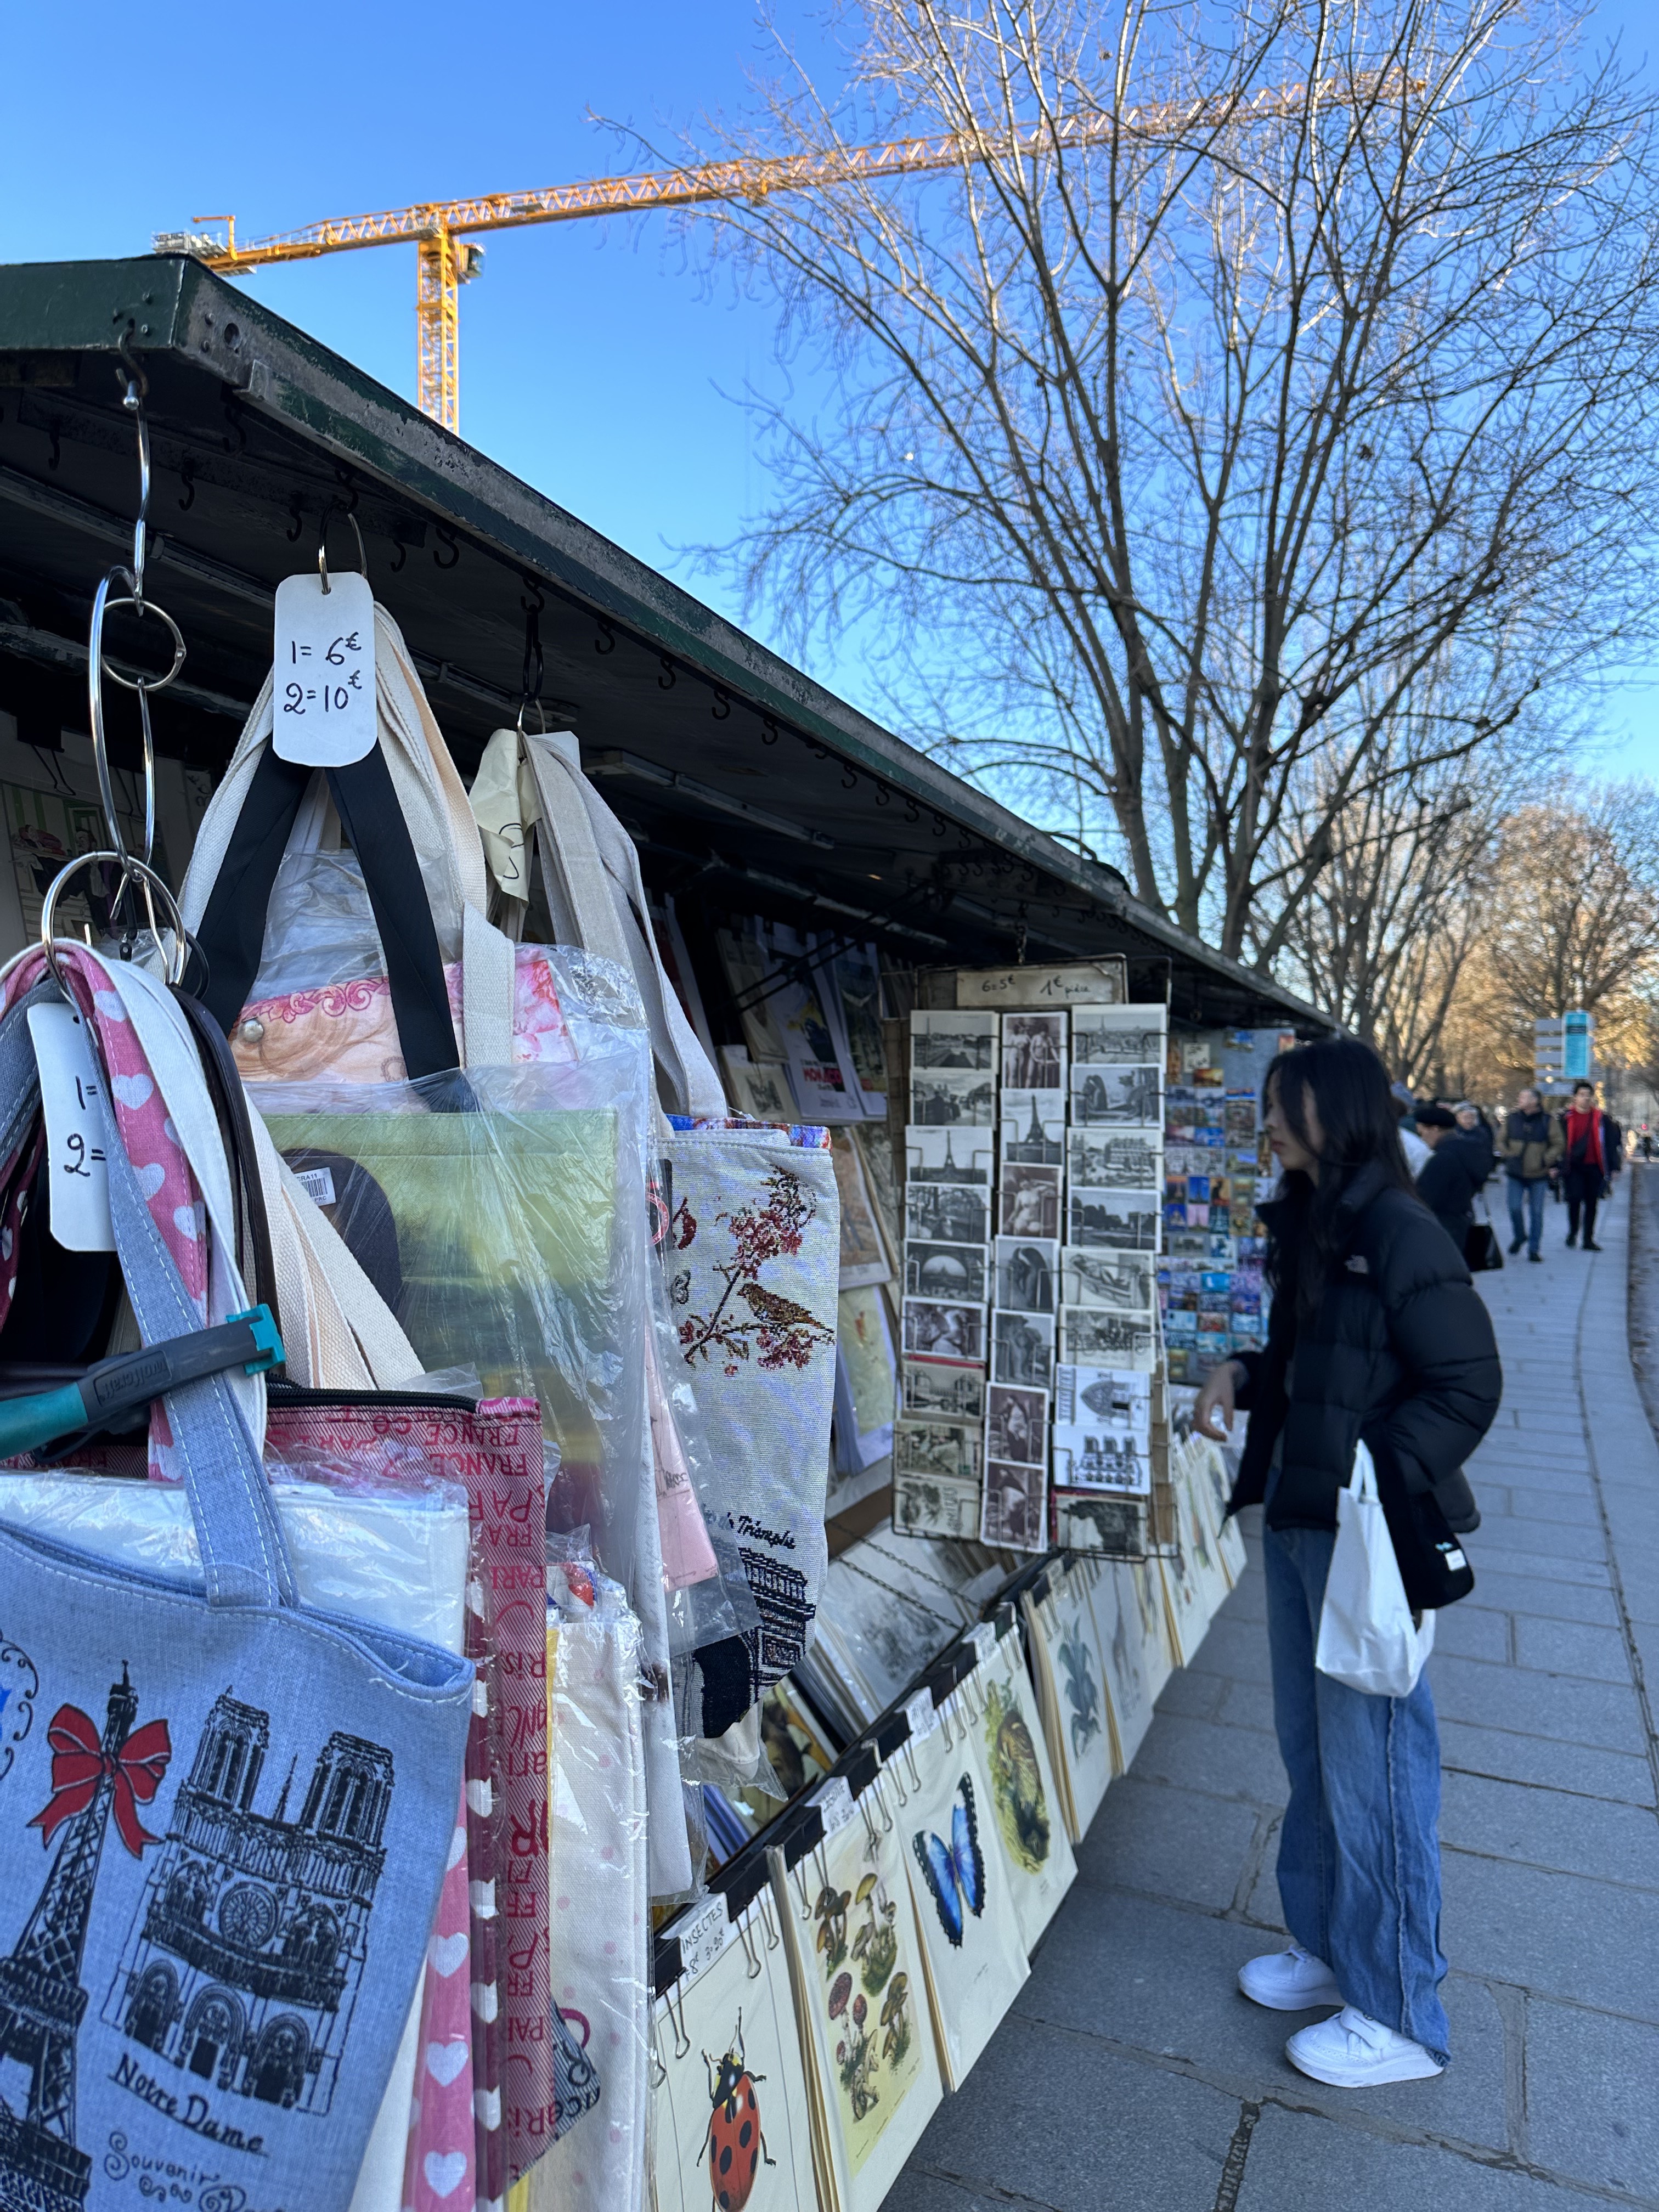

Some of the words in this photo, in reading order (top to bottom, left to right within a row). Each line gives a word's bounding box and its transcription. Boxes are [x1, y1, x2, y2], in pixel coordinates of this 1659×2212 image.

[681, 1901, 724, 1954] INSECTES
[112, 2052, 178, 2116] Notre
[182, 2093, 265, 2153] Dame
